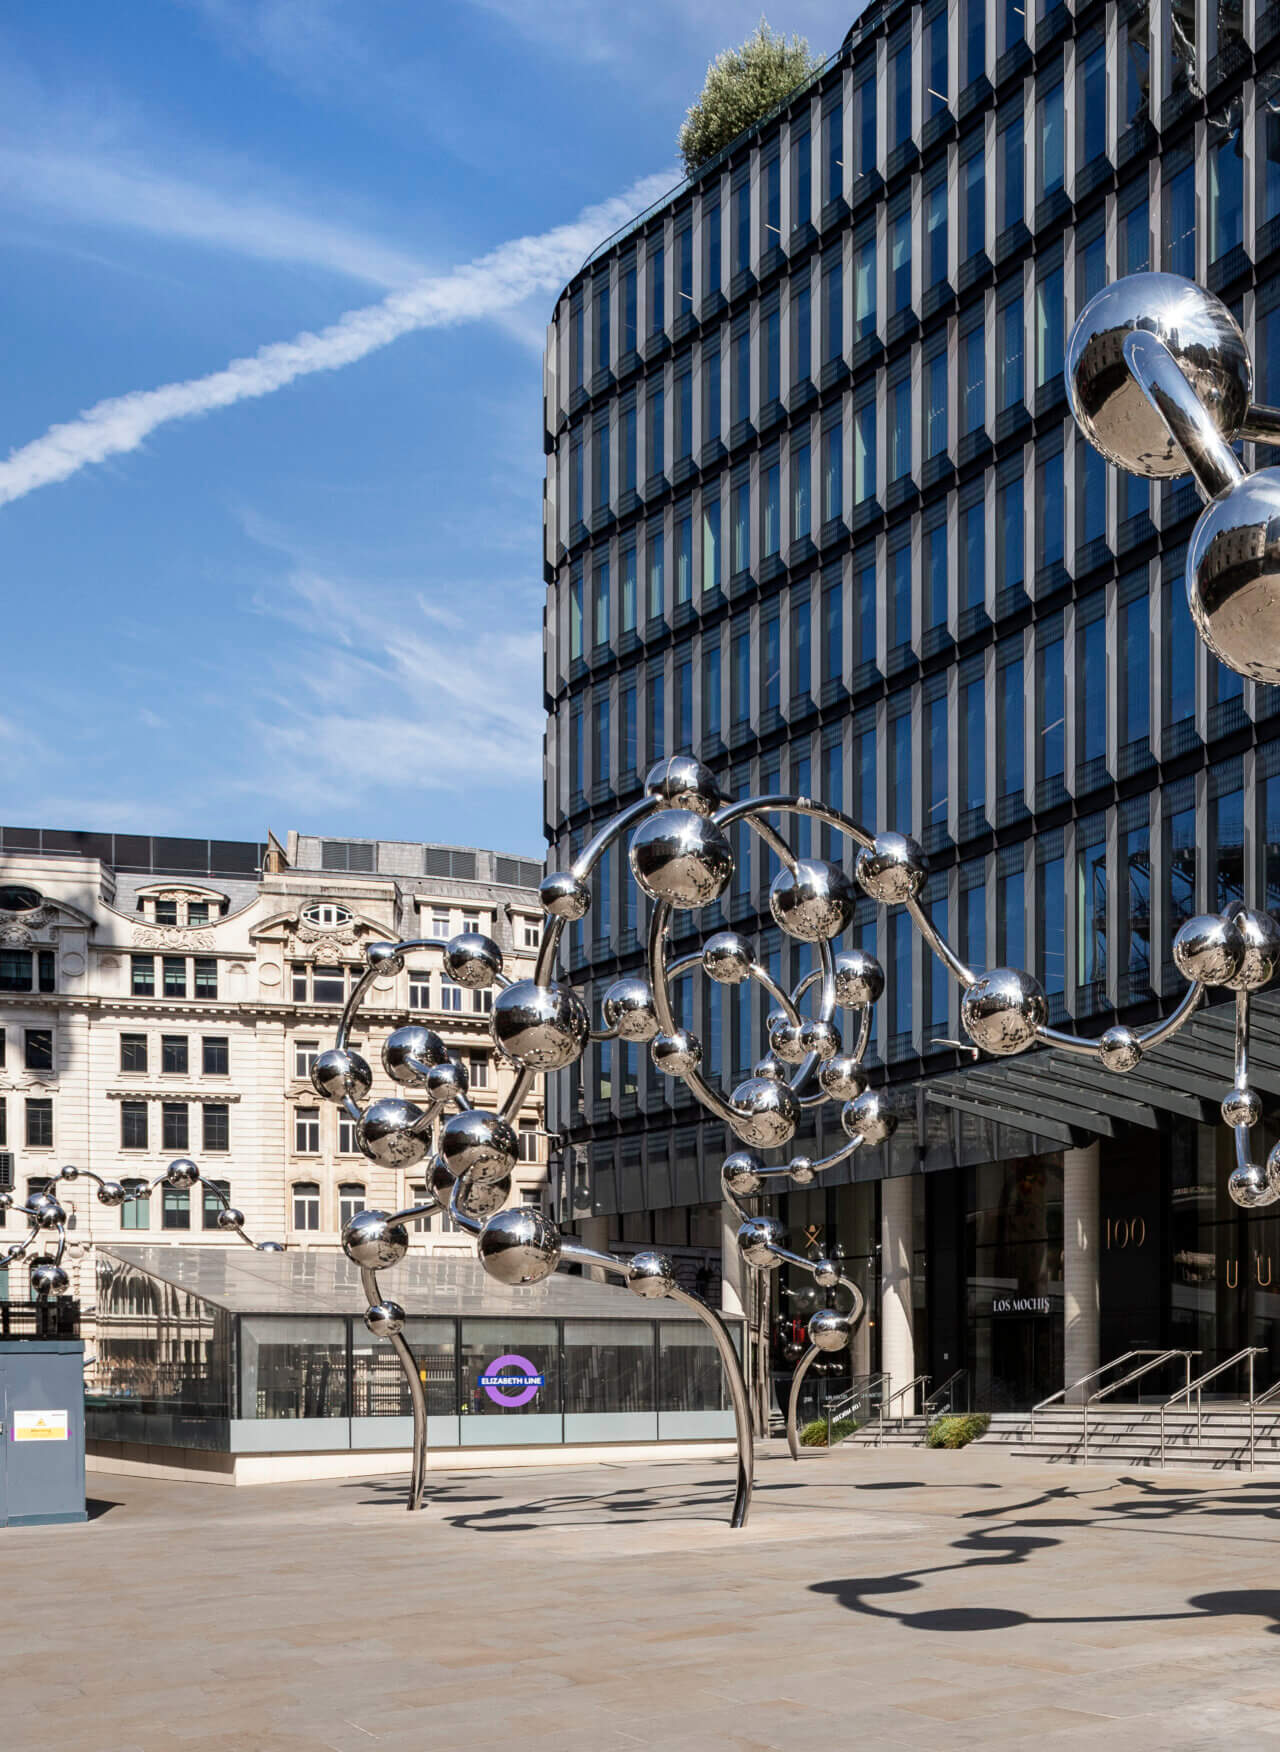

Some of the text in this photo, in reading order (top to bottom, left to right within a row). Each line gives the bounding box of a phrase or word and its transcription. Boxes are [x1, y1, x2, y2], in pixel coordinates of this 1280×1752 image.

[1107, 1216, 1146, 1249] 100
[993, 1297, 1050, 1312] LOS MOCHIS
[481, 1377, 542, 1385] ELIZABETH LINE
